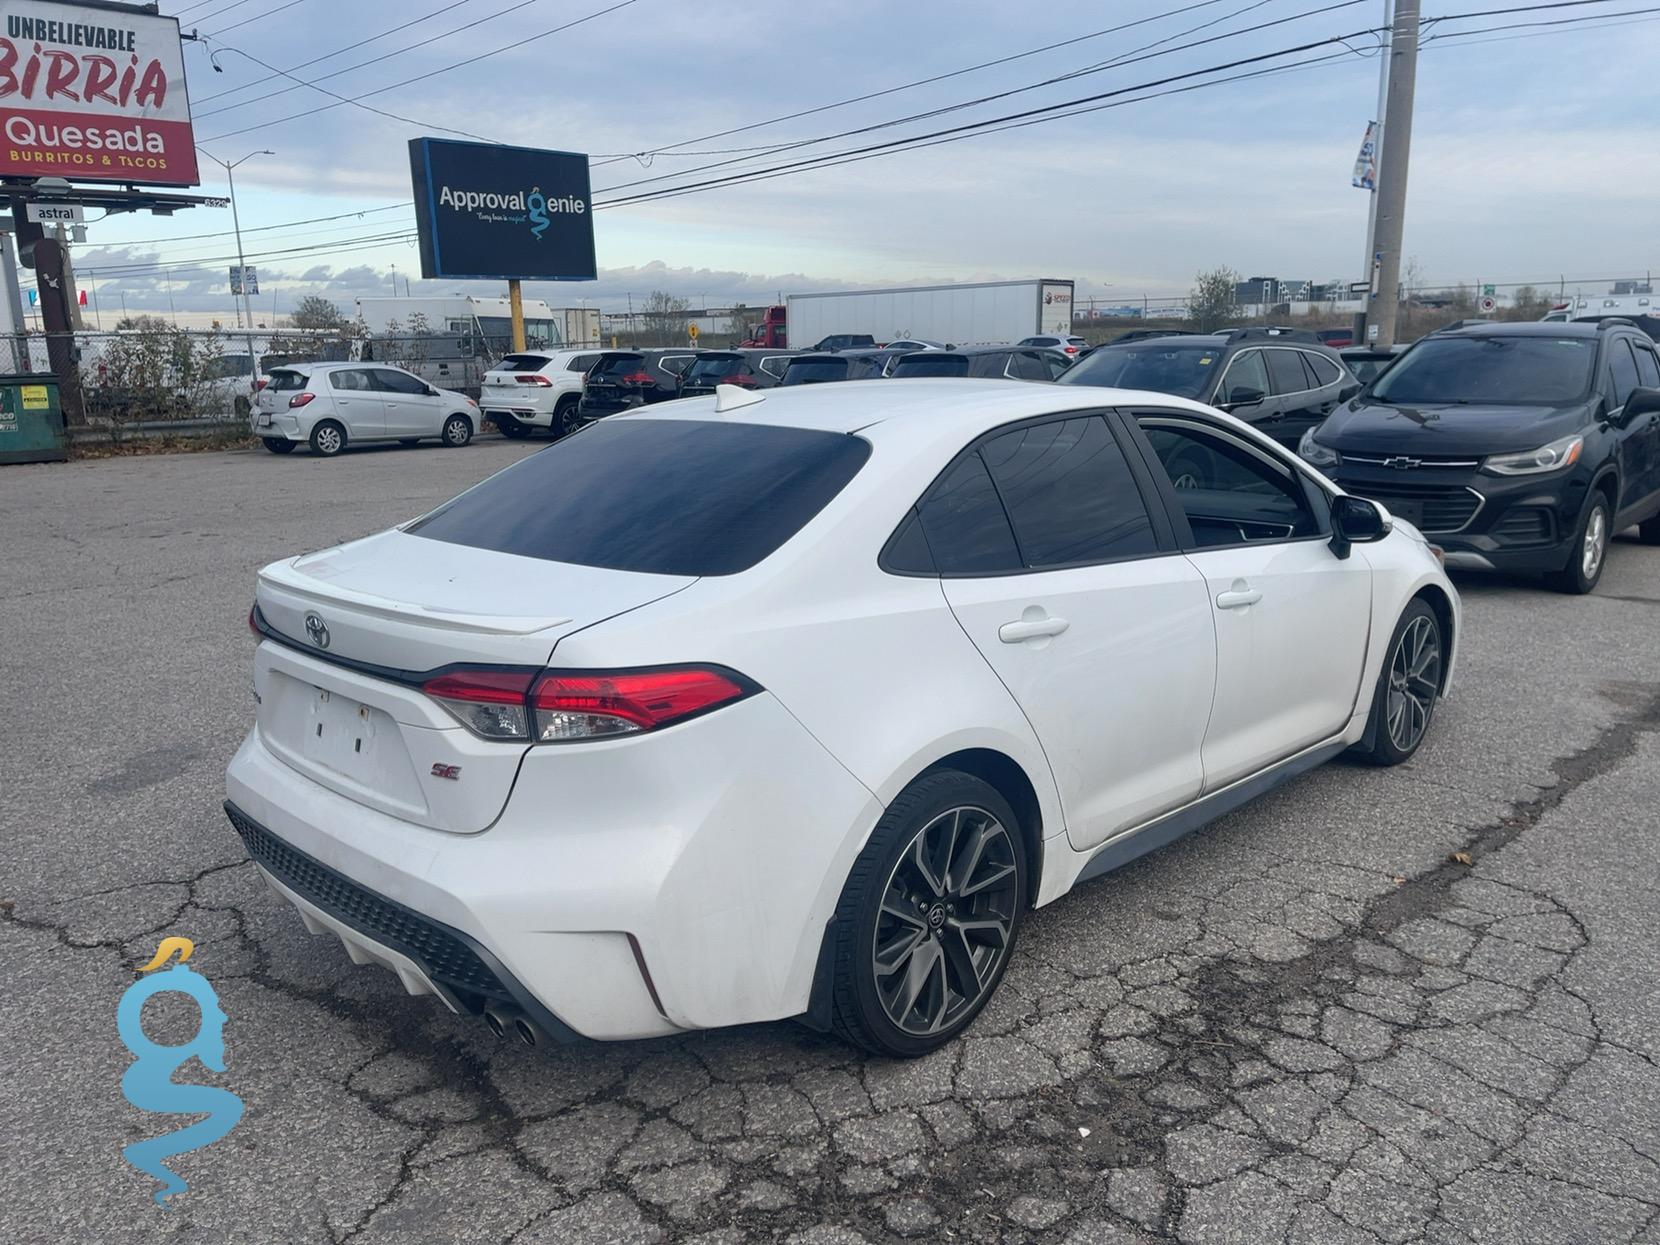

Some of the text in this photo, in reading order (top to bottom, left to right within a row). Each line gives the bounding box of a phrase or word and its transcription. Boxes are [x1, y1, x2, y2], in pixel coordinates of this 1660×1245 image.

[8, 15, 135, 52] UNBELIEVABLE
[5, 116, 164, 153] Quesada
[10, 151, 94, 164] BURRITOS
[102, 153, 111, 166] &
[38, 207, 74, 220] astral
